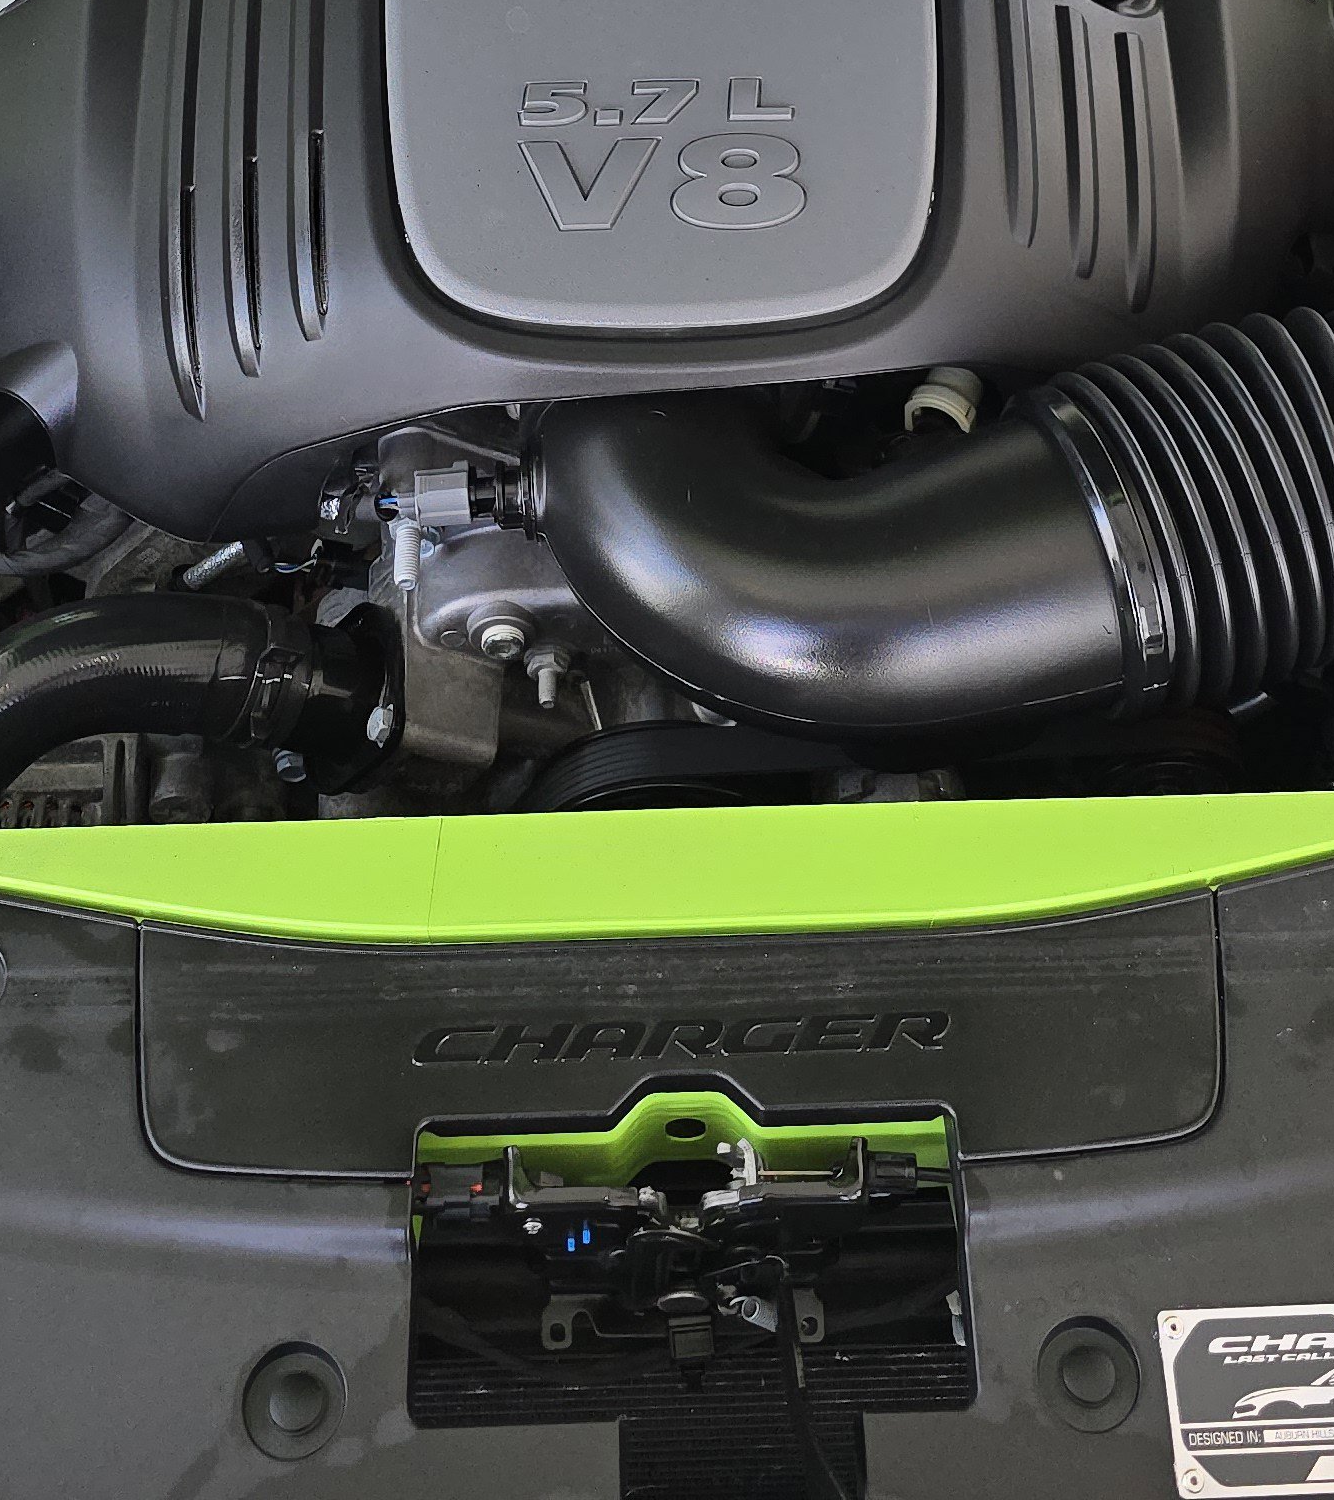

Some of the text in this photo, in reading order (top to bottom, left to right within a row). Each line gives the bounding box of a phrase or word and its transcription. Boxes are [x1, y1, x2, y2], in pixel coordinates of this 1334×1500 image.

[517, 75, 795, 127] 5.7 L
[517, 132, 808, 231] V8
[411, 1009, 952, 1066] CHARGER
[1223, 1353, 1281, 1365] LAST
[1188, 1431, 1244, 1446] DESIGNED
[1247, 1430, 1263, 1444] IN:
[1274, 1429, 1310, 1440] AUBURN
